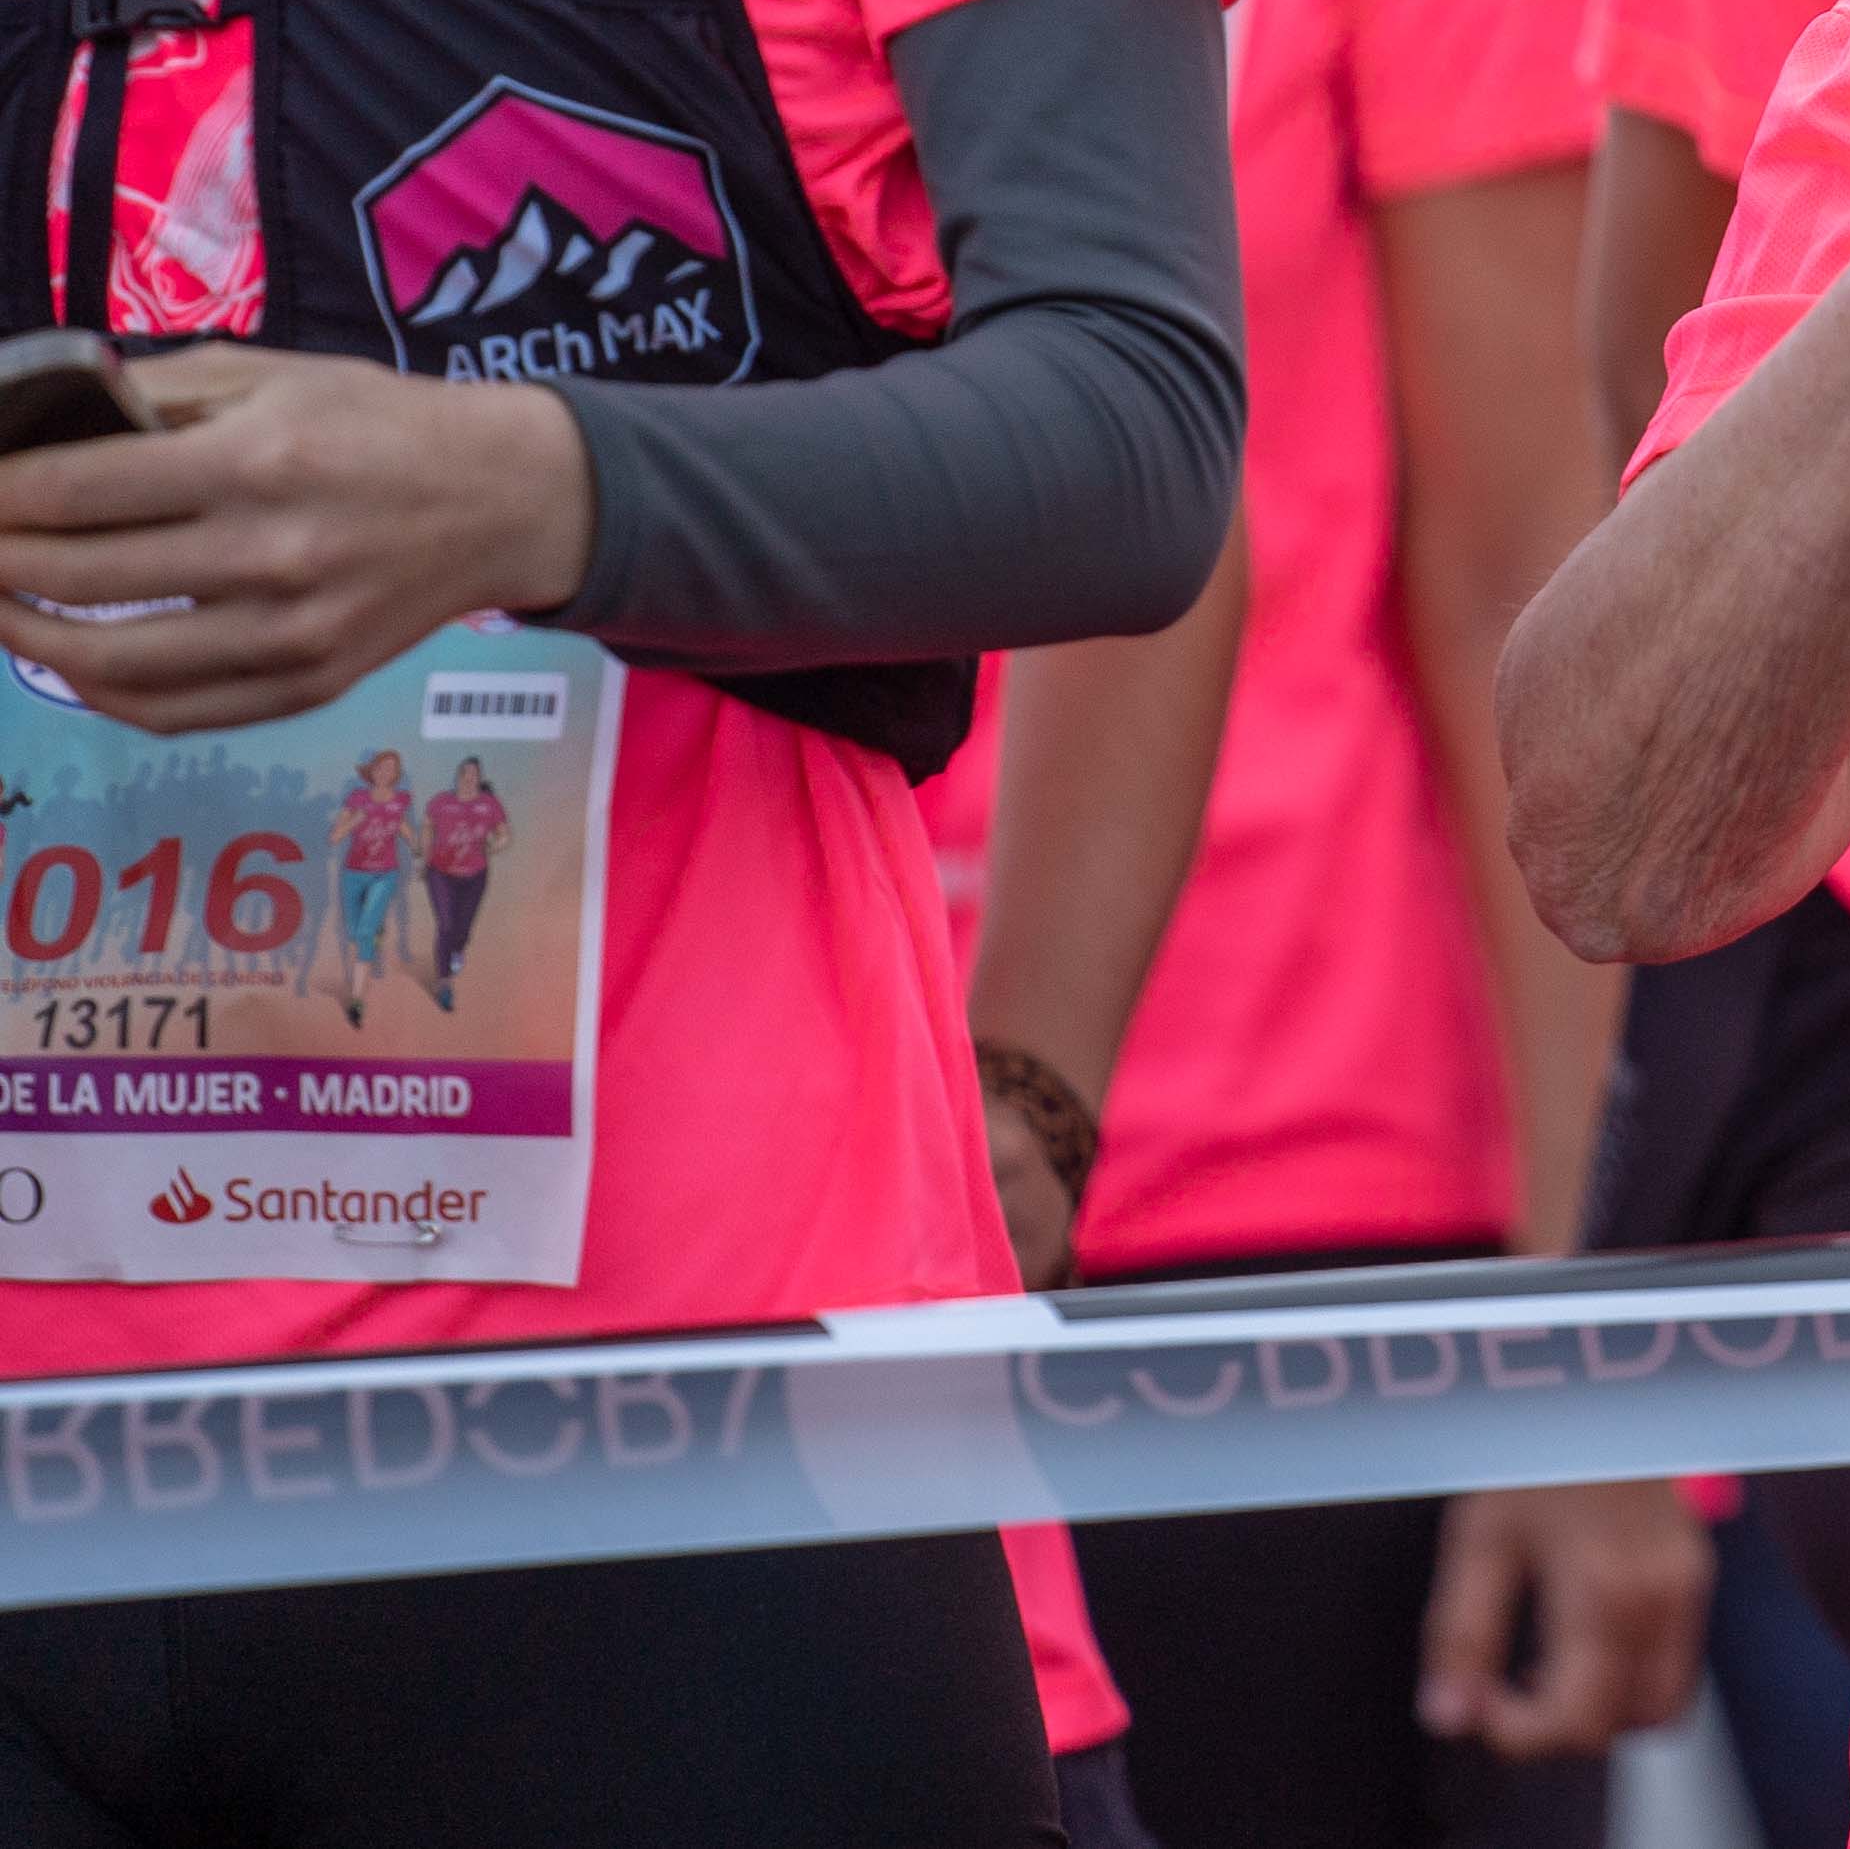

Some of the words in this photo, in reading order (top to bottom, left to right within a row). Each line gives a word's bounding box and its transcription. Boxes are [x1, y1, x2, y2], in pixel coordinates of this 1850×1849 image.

[4, 830, 305, 963] 016
[33, 995, 210, 1050] 13171
[48, 1072, 101, 1115] LA
[113, 1072, 263, 1117] MUJER
[299, 1072, 472, 1118] MADRID
[224, 1177, 487, 1224] Santander
